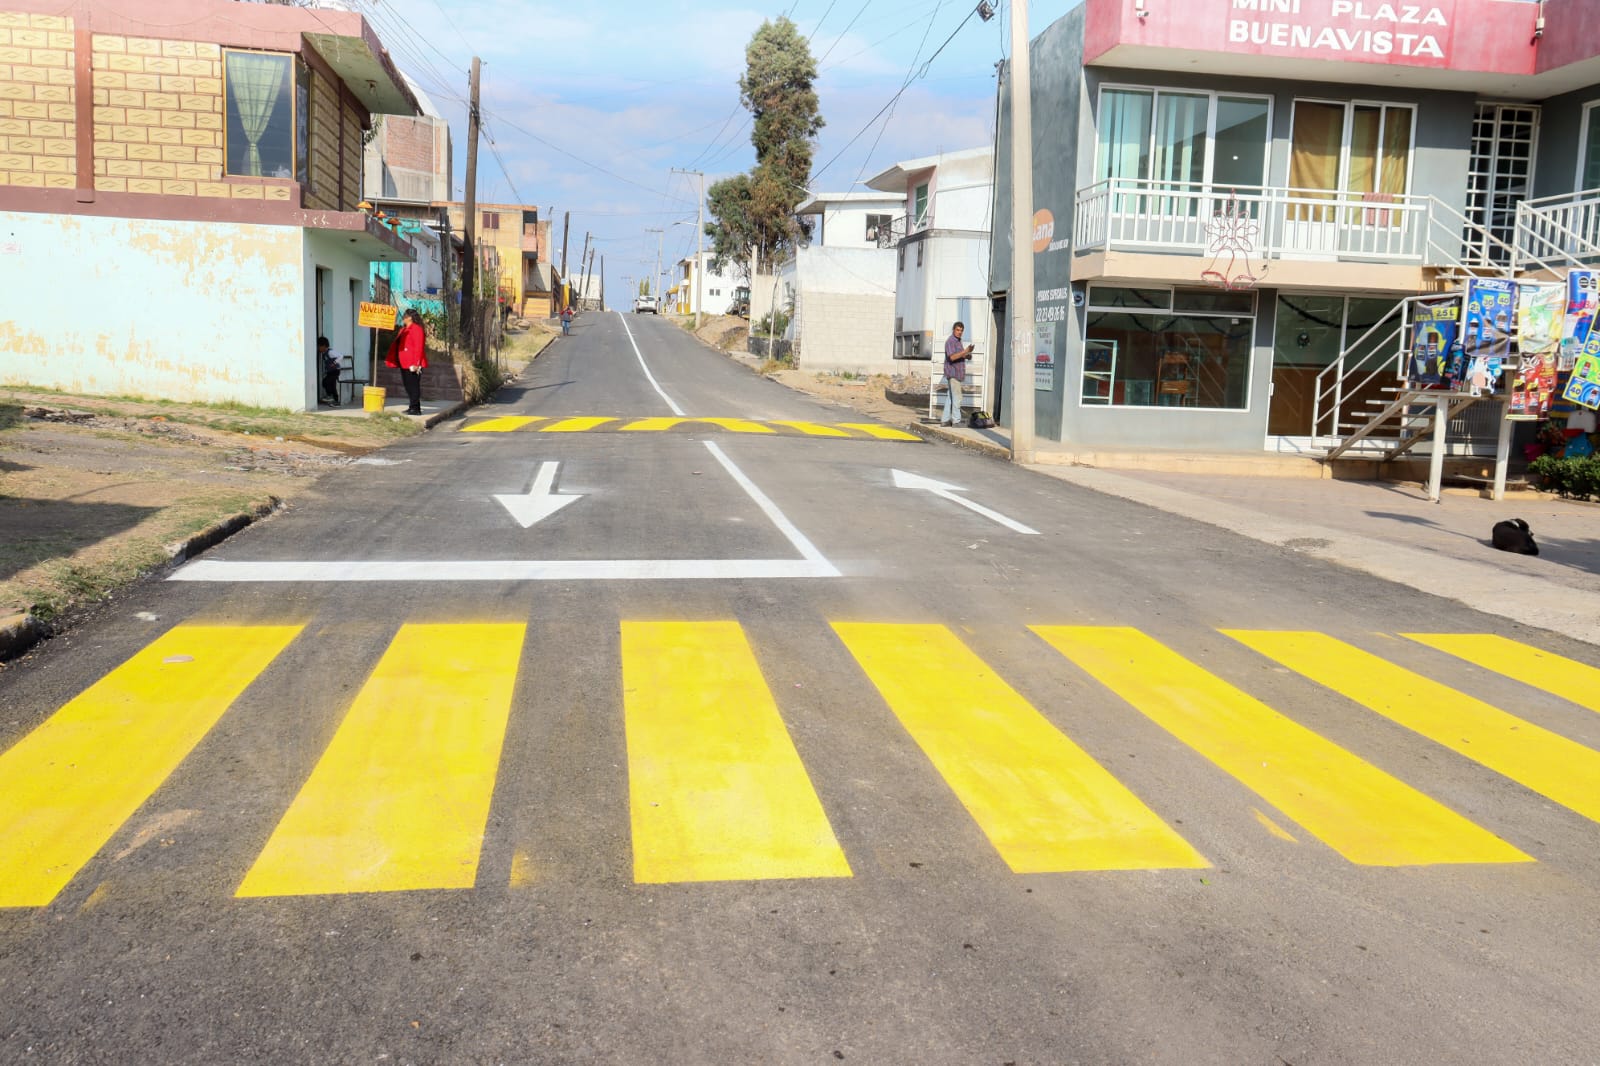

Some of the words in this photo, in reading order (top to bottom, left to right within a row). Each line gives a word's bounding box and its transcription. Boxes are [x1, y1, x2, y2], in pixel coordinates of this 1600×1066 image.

[1232, 0, 1300, 14] MINI
[1331, 0, 1447, 26] PLAZA
[1229, 19, 1445, 58] BUENAVISTA
[1477, 279, 1509, 290] PEPSI
[360, 303, 395, 316] NOVEDADES
